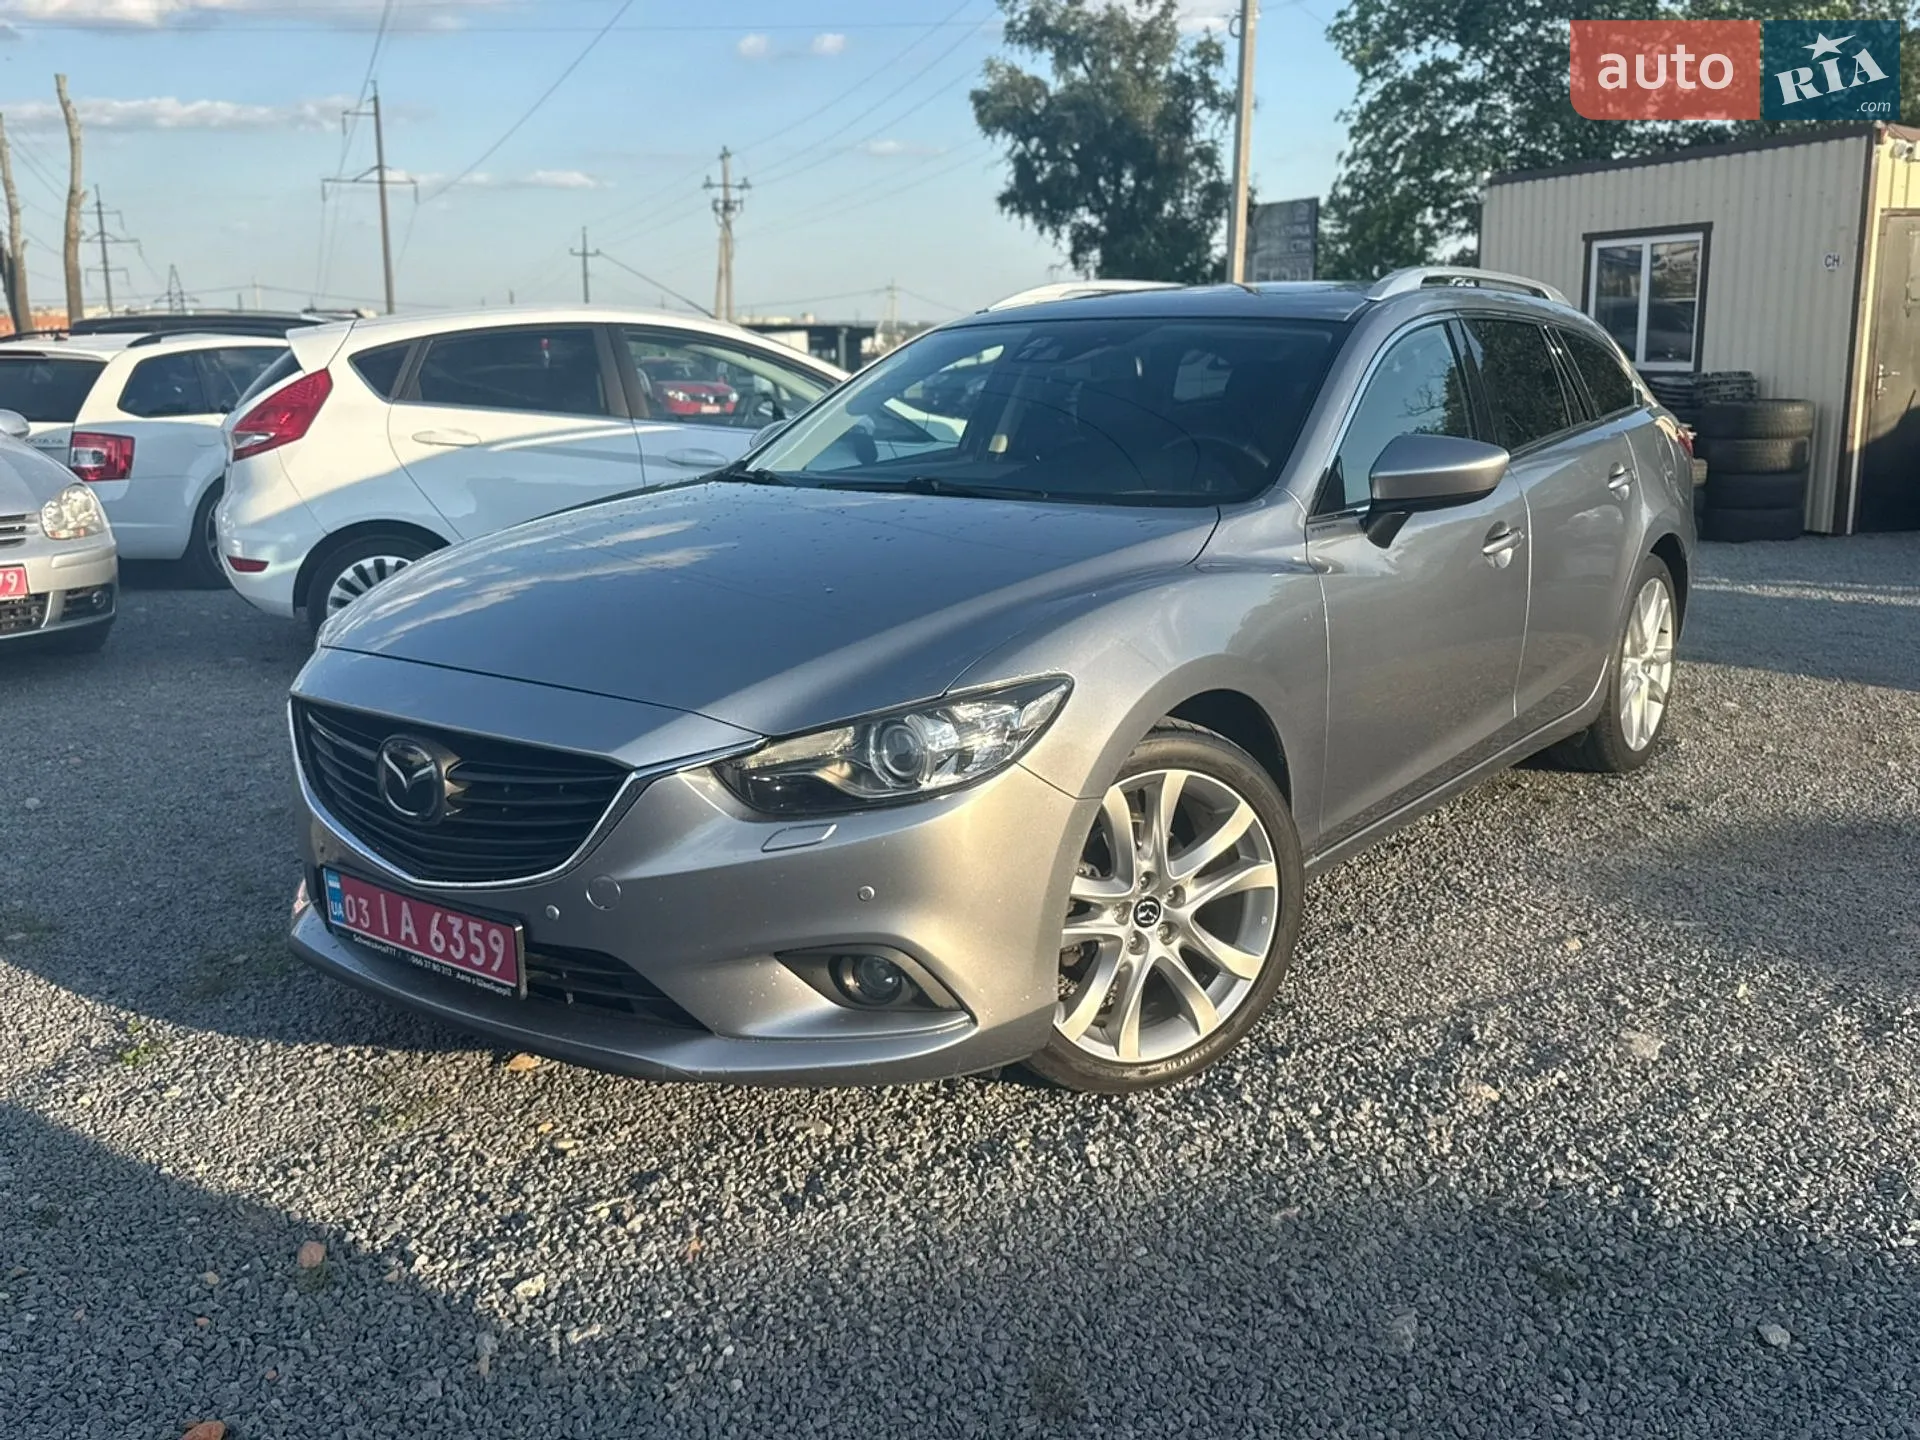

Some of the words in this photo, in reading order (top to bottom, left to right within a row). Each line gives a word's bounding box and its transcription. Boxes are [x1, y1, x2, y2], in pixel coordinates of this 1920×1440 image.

[330, 901, 344, 919] UA
[344, 893, 371, 929] 03
[430, 911, 505, 972] 6359
